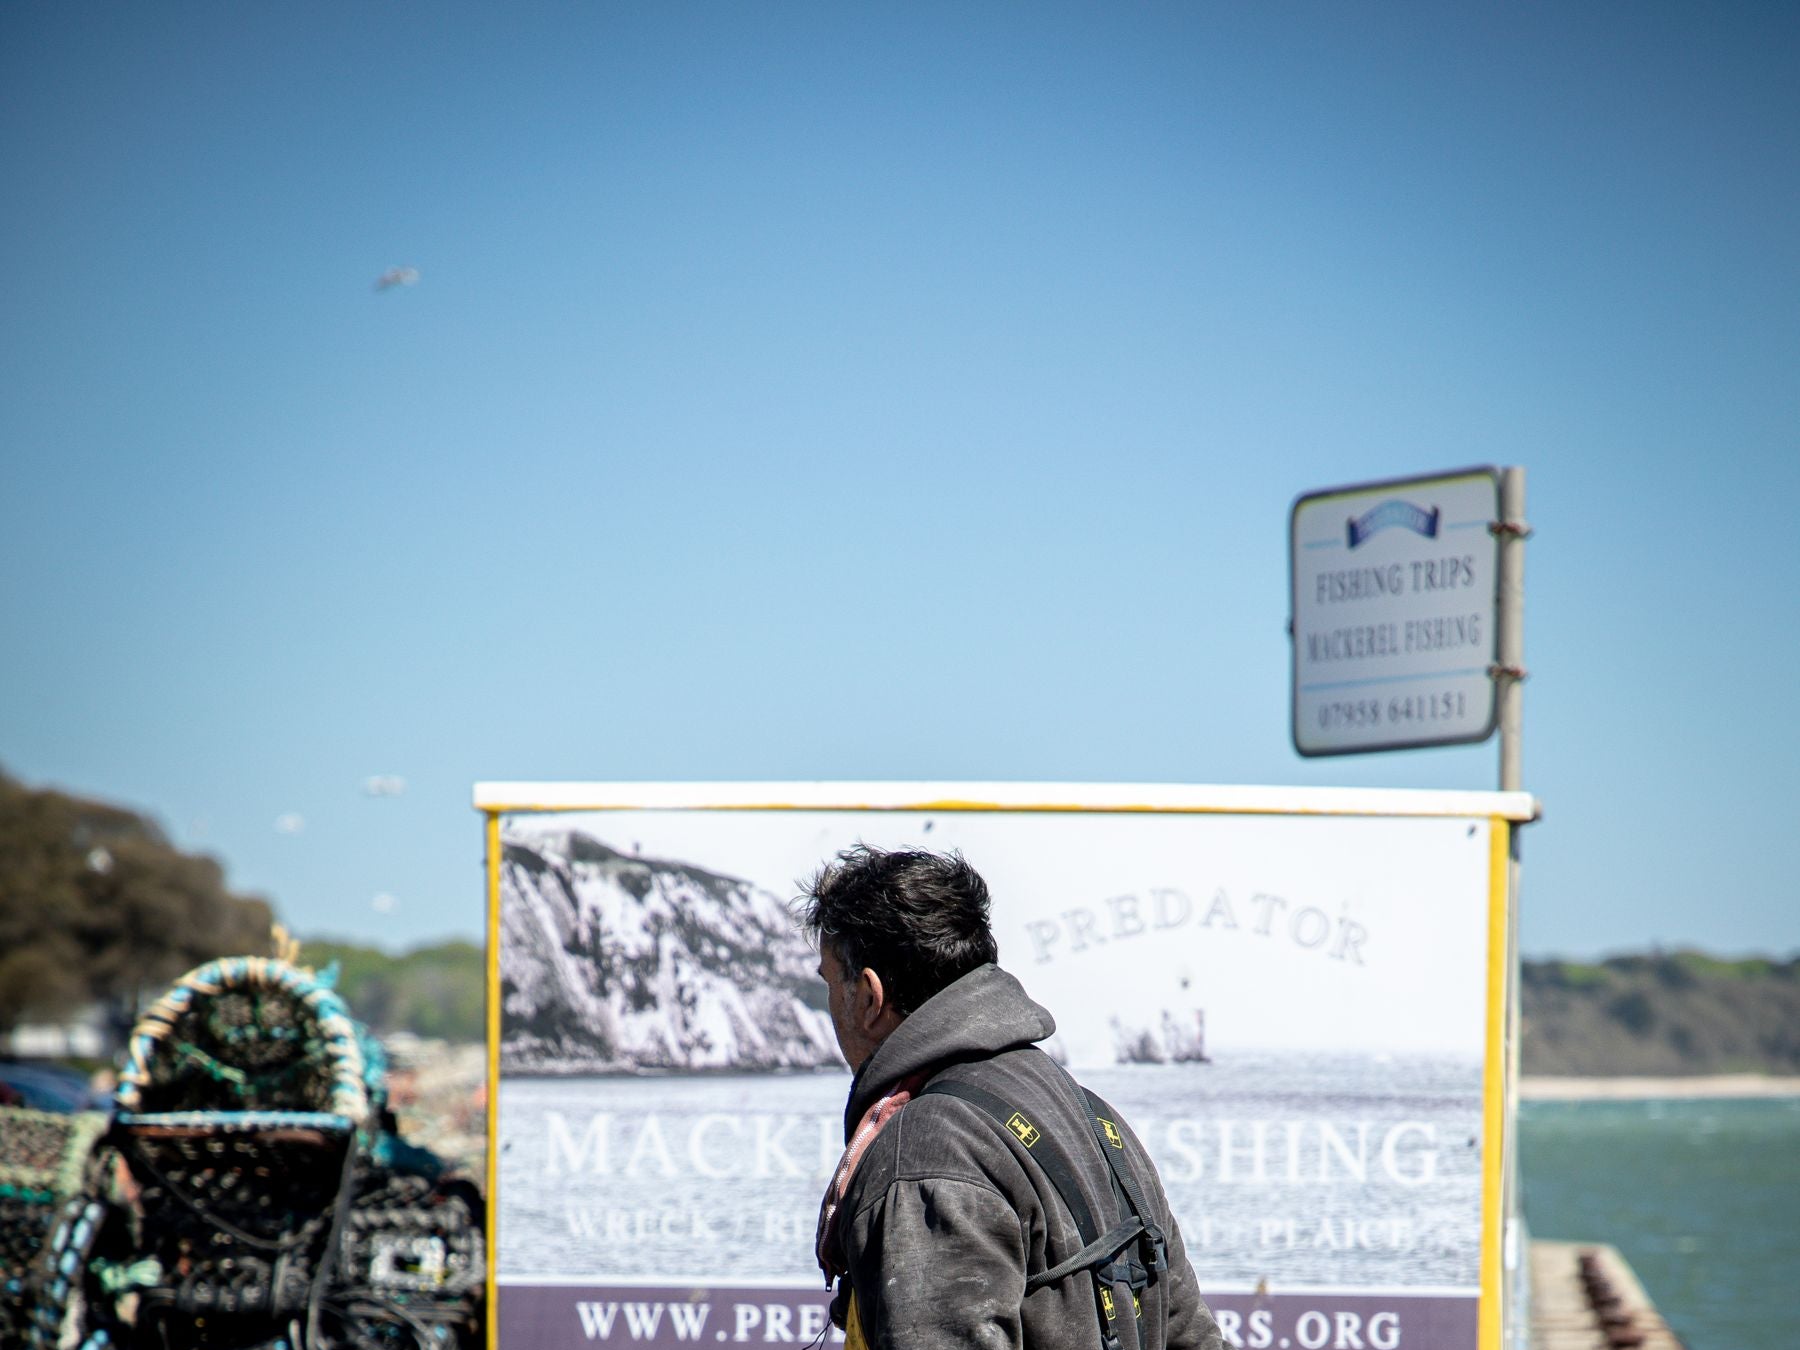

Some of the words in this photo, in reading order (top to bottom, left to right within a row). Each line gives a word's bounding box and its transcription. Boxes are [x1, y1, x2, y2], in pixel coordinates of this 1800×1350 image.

[1317, 566, 1402, 601] FISHING
[1411, 557, 1473, 592] TRIPS
[1308, 625, 1396, 661] MACKEREL
[1405, 614, 1480, 653] FISHING
[1389, 691, 1465, 722] 641151
[1025, 886, 1370, 967] PREDATOR
